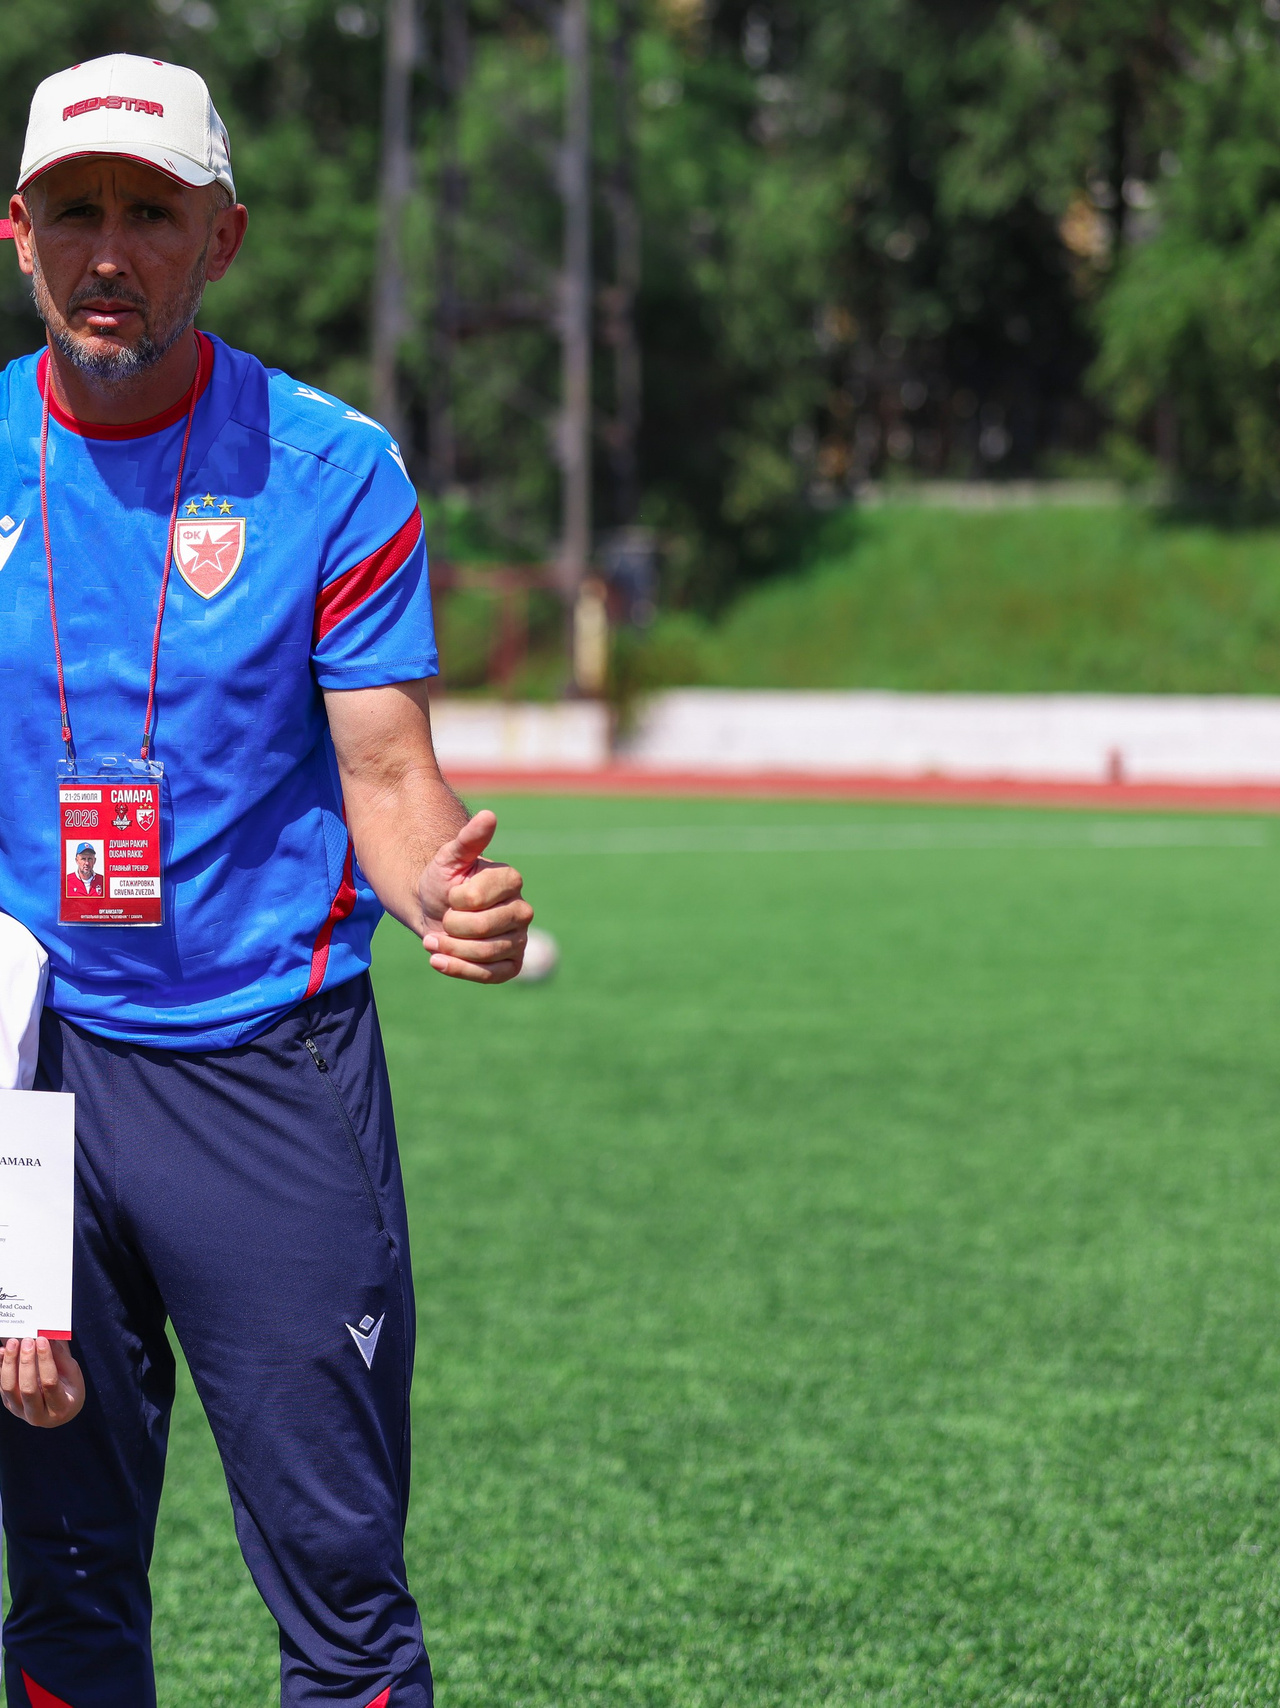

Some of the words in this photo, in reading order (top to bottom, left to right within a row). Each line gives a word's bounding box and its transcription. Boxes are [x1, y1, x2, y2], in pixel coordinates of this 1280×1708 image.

[183, 531, 201, 540] ФК
[111, 790, 153, 803] САМАРА
[65, 809, 98, 827] 2026
